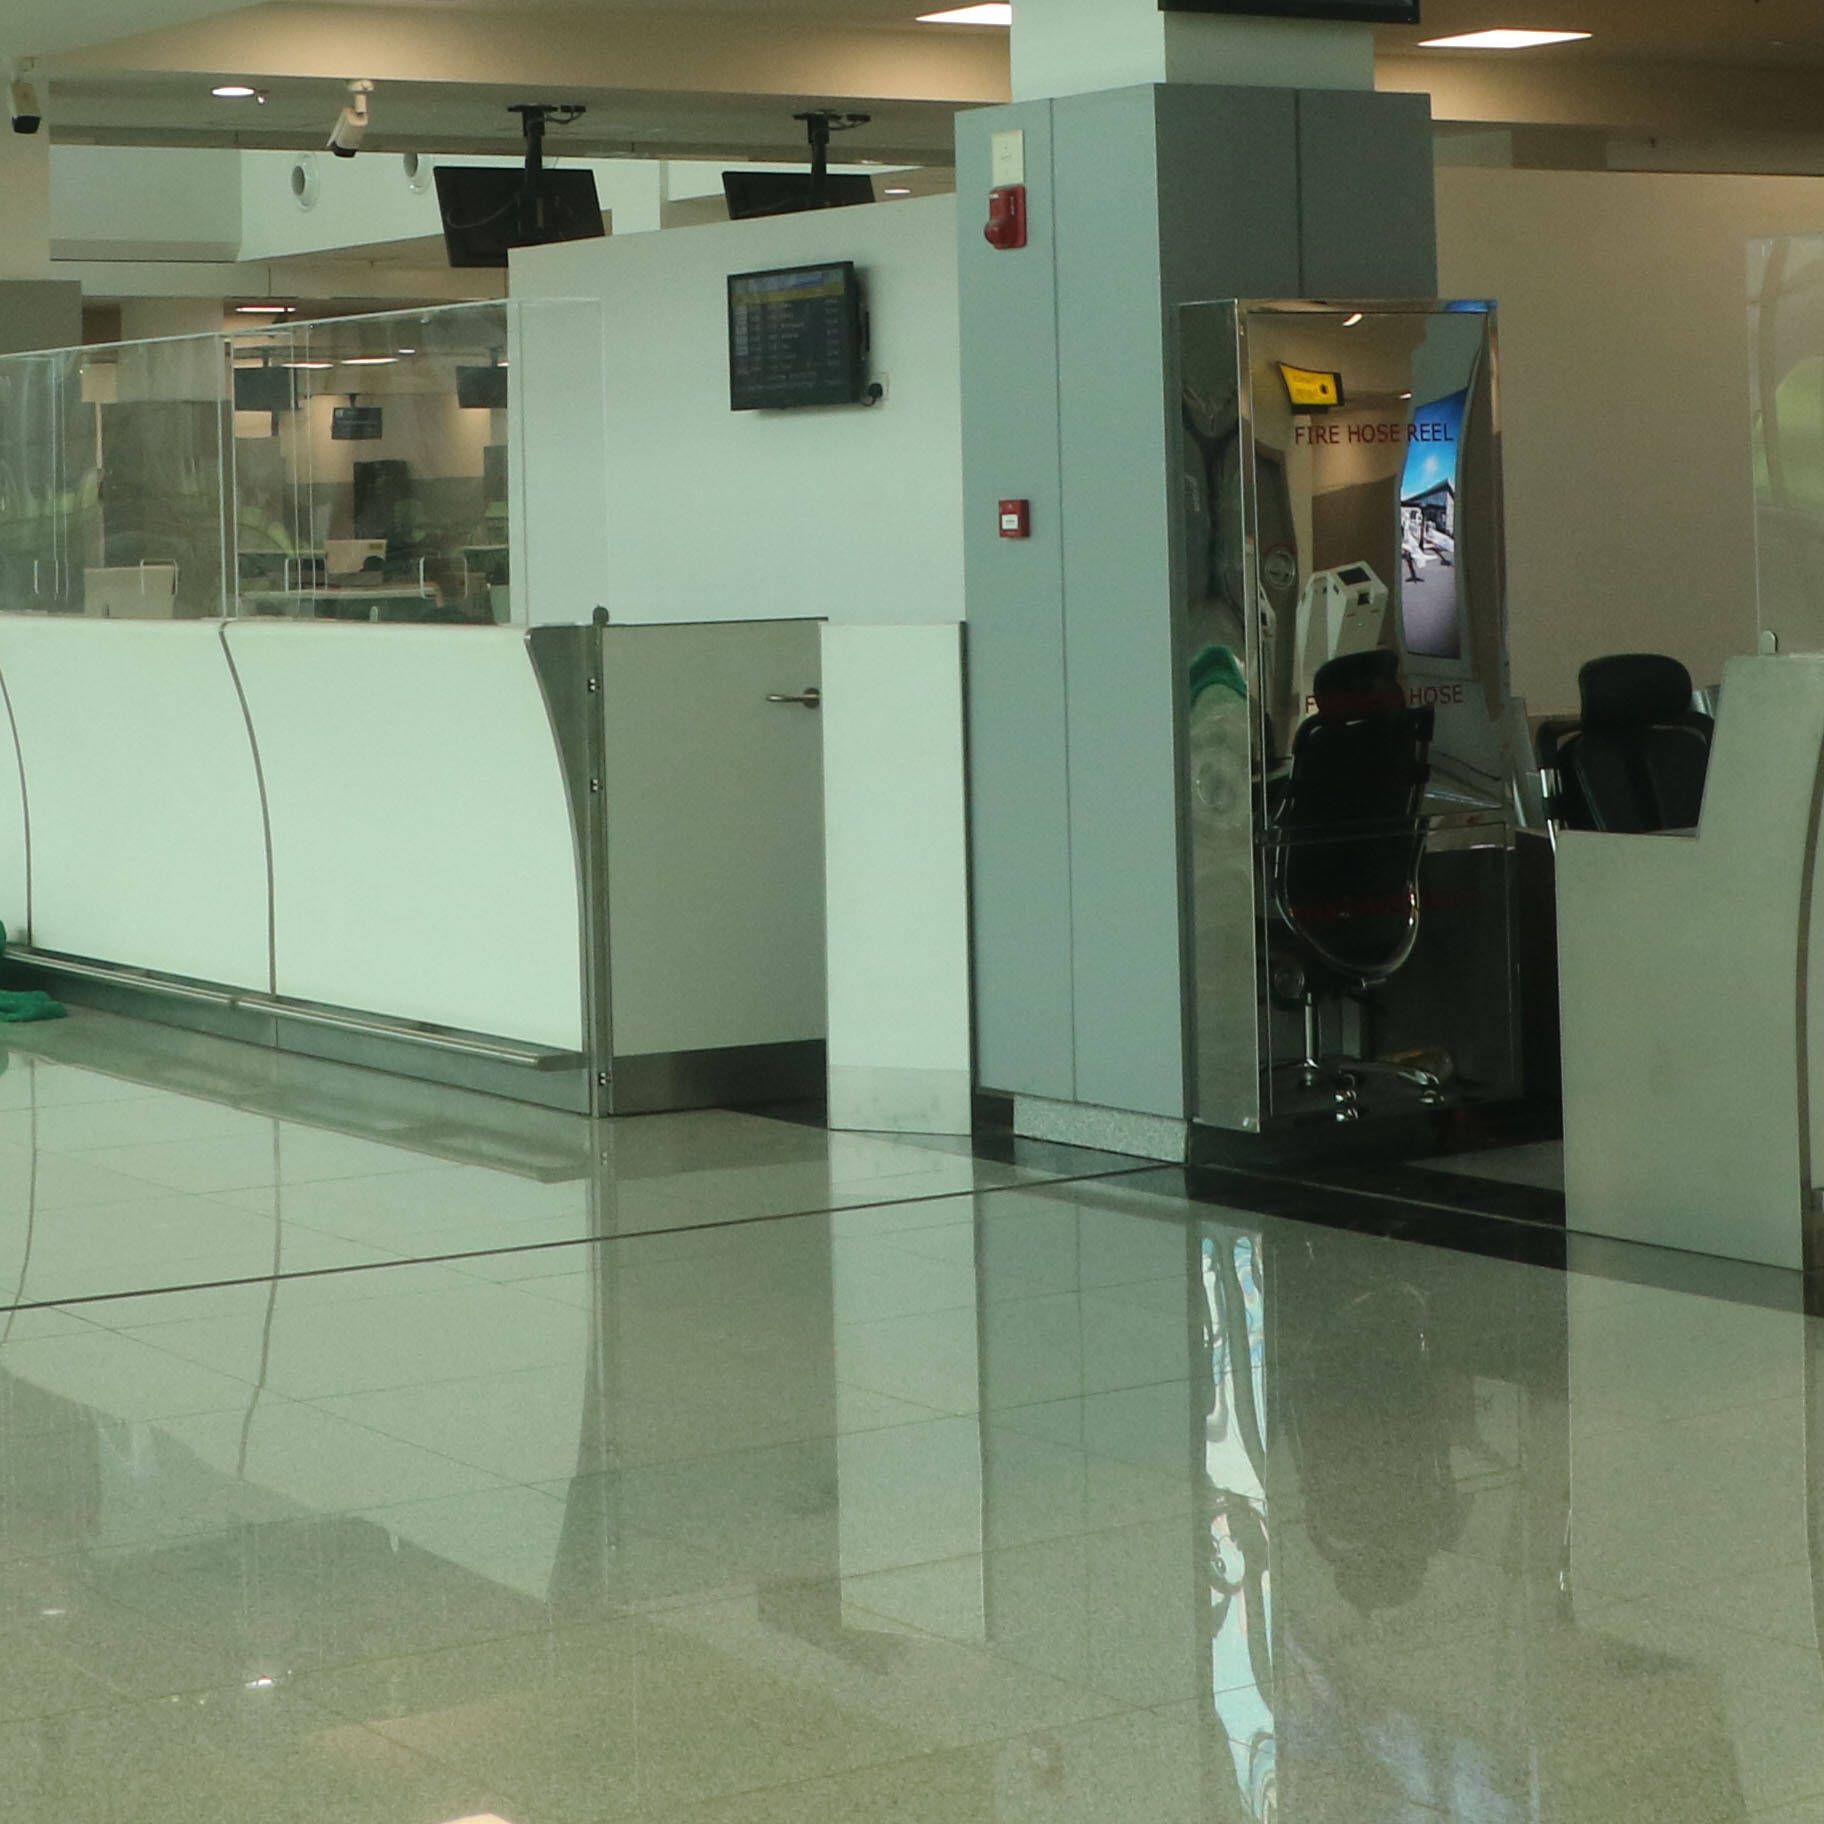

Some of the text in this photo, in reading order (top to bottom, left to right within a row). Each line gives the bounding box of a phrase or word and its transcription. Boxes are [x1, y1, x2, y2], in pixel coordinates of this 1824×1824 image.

[1294, 423, 1455, 445] FIRE HOSE REEL
[1409, 684, 1464, 706] HOSE
